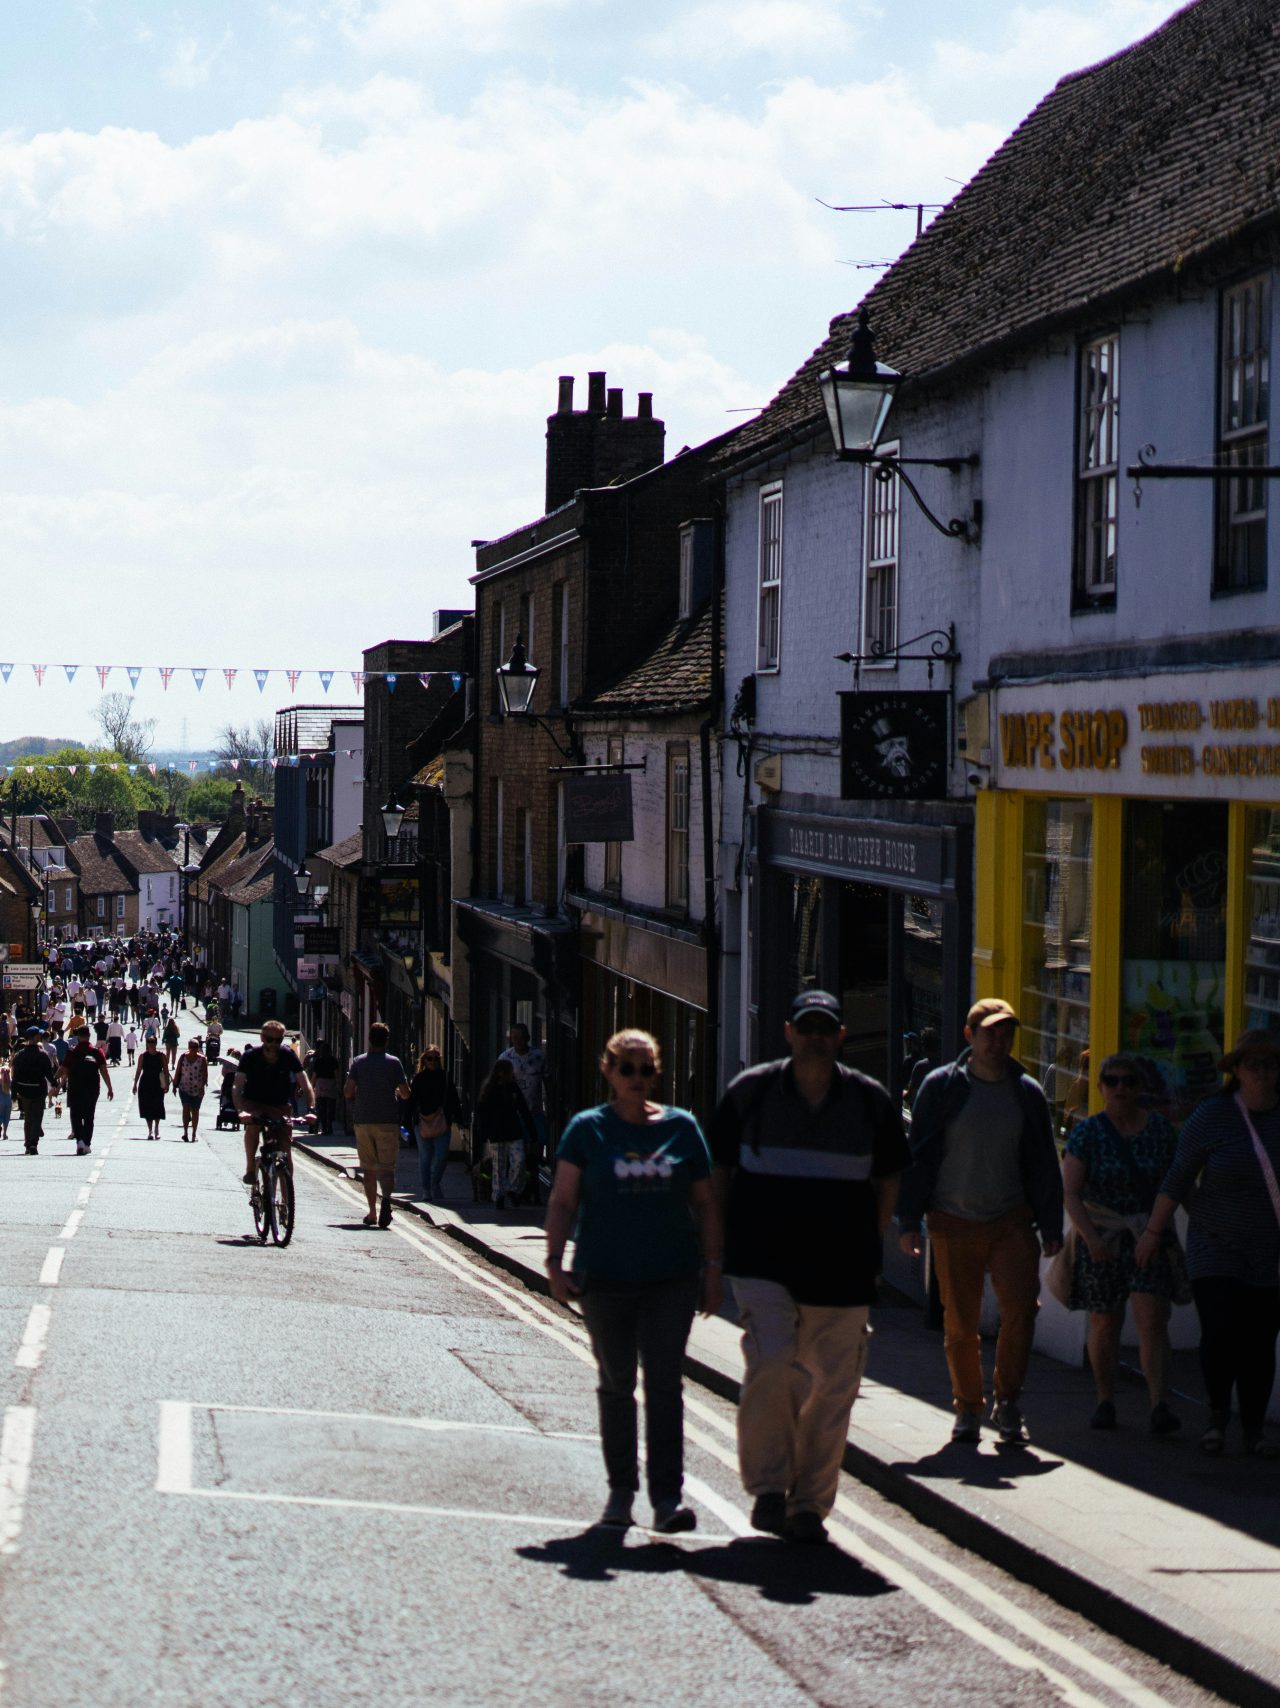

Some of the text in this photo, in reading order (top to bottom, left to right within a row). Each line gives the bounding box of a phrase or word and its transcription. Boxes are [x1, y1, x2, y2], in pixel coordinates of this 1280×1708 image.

[999, 709, 1129, 770] VAPE SHOP
[789, 827, 917, 873] TAMARIN BAY COFFEE HOUSE
